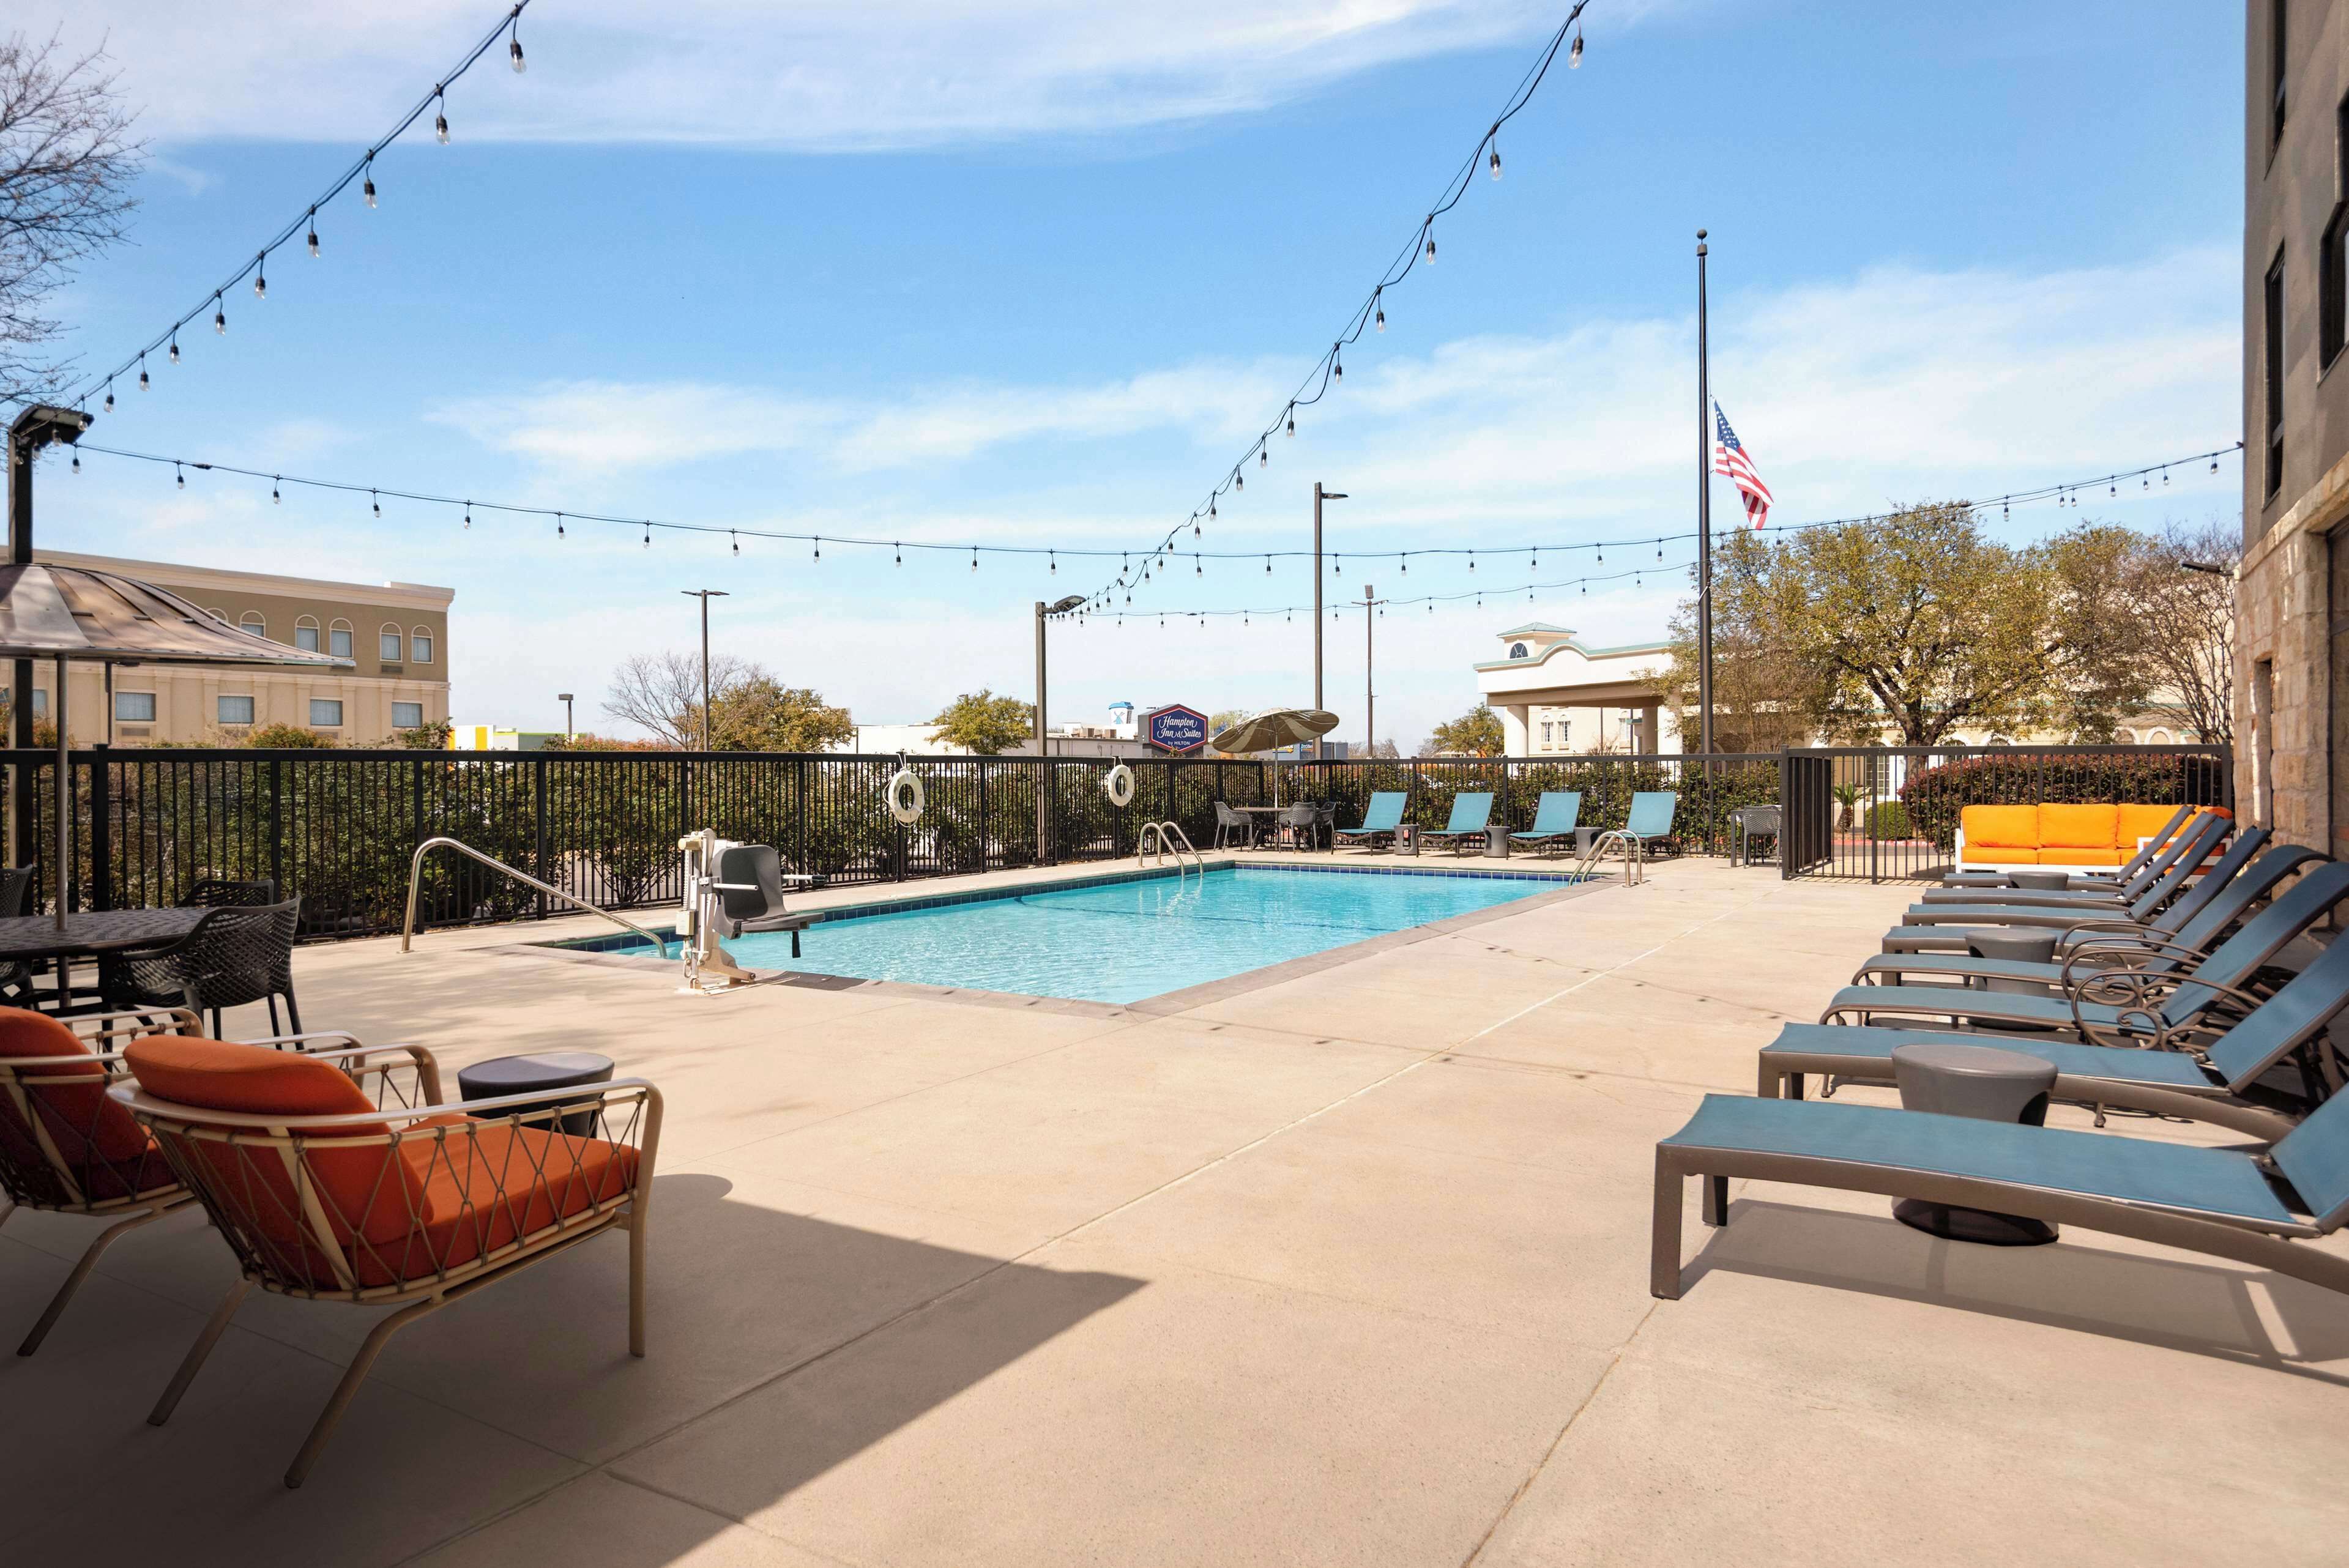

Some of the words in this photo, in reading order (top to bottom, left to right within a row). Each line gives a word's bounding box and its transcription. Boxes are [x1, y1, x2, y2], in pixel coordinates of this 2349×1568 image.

[1158, 715, 1197, 728] Hampton
[1156, 728, 1177, 738] Inn
[1181, 728, 1201, 738] Suites
